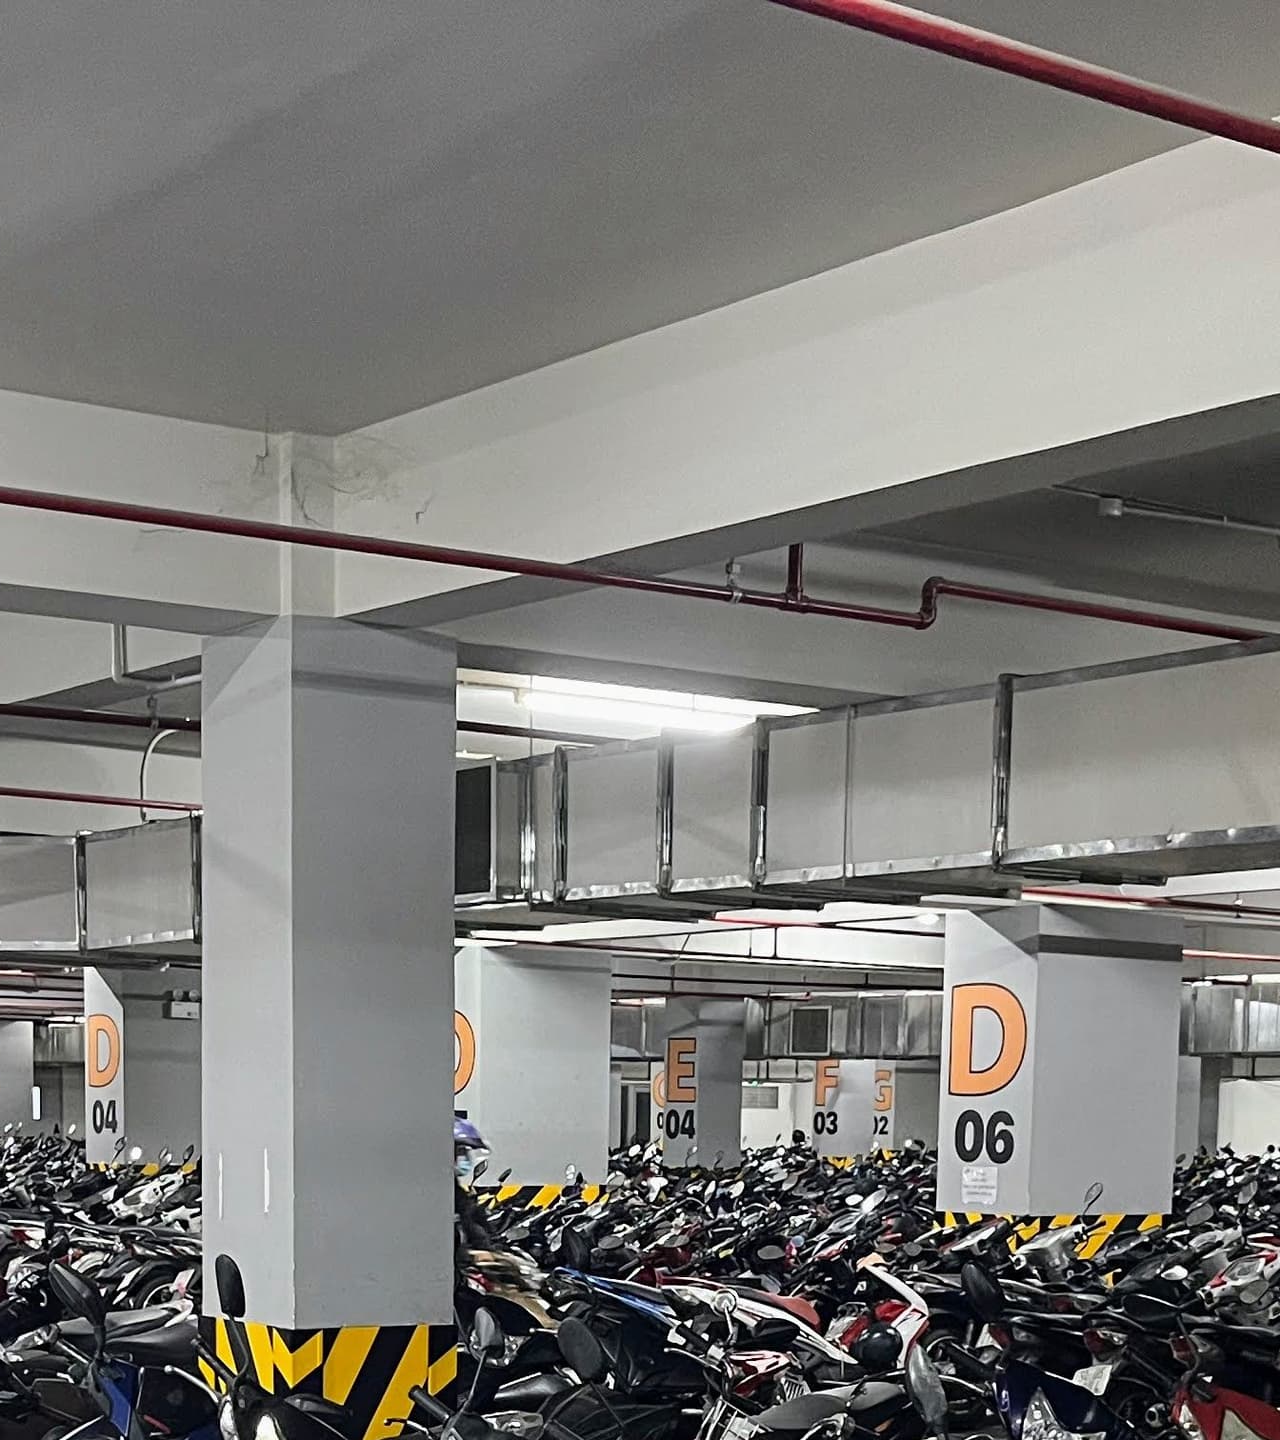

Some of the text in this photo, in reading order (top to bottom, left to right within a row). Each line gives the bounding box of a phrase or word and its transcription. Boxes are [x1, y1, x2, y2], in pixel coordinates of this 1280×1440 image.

[87, 1013, 120, 1087] D
[948, 982, 1027, 1097] D
[666, 1037, 697, 1103] E
[814, 1059, 840, 1106] F
[92, 1099, 118, 1134] 04
[665, 1109, 696, 1140] 04
[813, 1111, 839, 1136] 03
[954, 1109, 1015, 1164] 06
